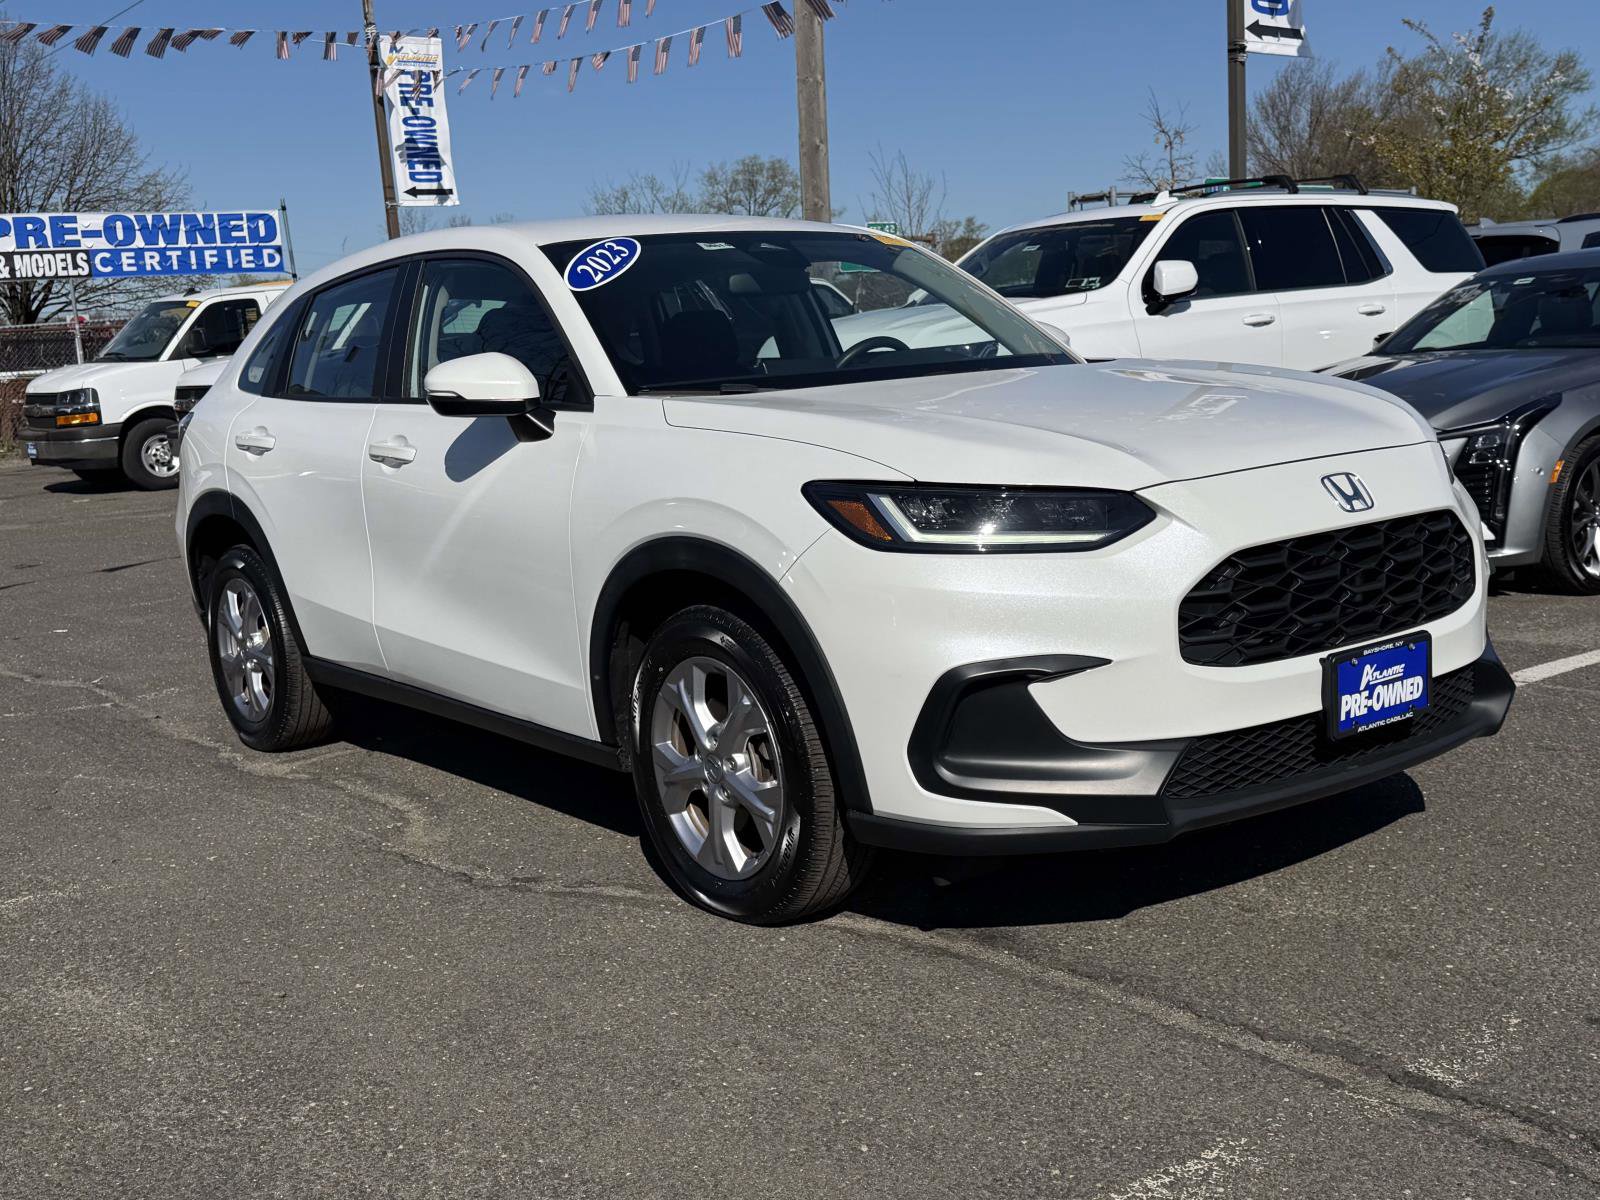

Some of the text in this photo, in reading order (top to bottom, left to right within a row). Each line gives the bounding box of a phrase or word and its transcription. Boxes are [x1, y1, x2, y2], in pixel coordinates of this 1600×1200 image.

[13, 252, 90, 278] MODELS
[94, 248, 281, 273] CERTIFIED
[576, 242, 629, 283] 2023
[1360, 663, 1406, 691] ATLANTIC
[1340, 675, 1424, 721] PRE-OWNED
[1357, 711, 1414, 733] ATLANTIC CADILLAC
